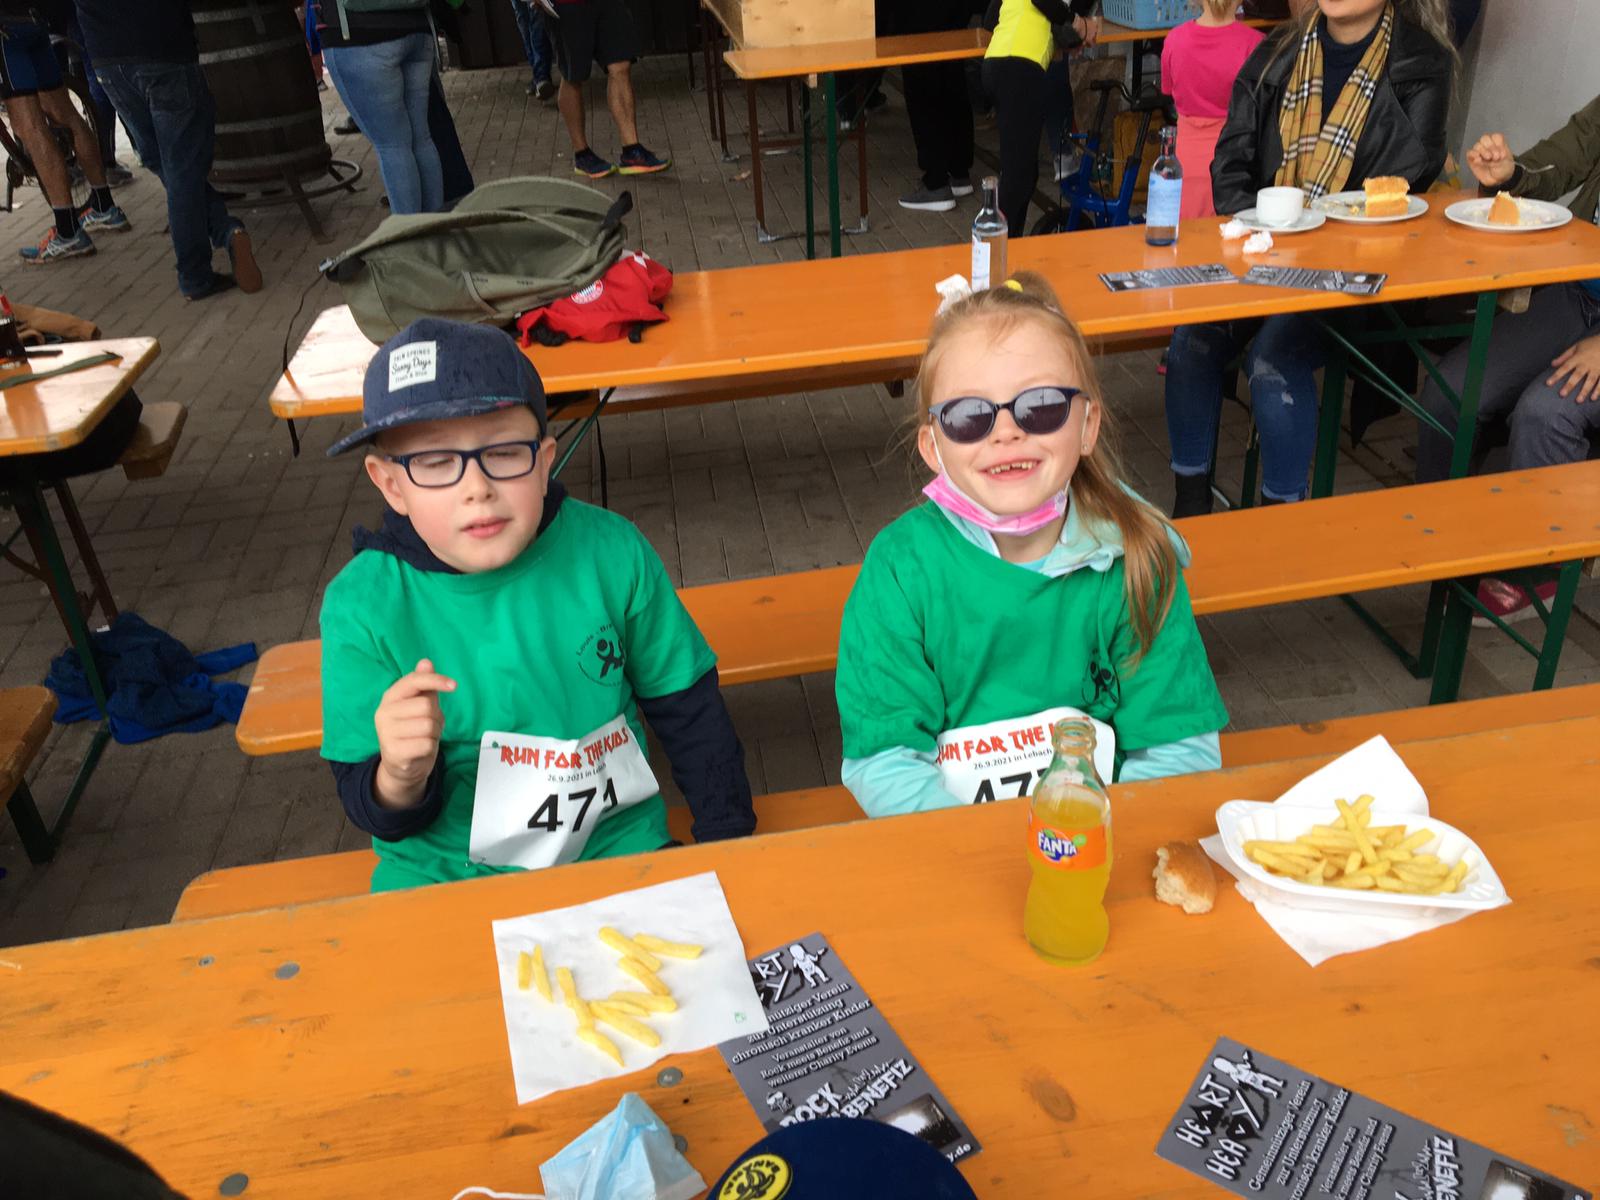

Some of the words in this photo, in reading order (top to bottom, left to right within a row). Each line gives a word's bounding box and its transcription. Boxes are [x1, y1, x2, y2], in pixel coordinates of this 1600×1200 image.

[500, 744, 540, 768] RUN
[544, 749, 582, 769] FOR
[583, 744, 604, 767] THE
[602, 726, 629, 755] KIDS
[963, 735, 1008, 761] FOR
[1008, 727, 1045, 754] THE
[974, 757, 1012, 770] 26.9.2021
[1014, 753, 1022, 762] in
[1023, 748, 1053, 761] Lebach
[548, 773, 584, 782] 26.9.2021
[527, 778, 618, 832] 471
[1038, 831, 1078, 855] FANTA
[767, 998, 845, 1035] Unterstützung
[813, 982, 850, 1002] Verein
[732, 1038, 788, 1064] chronisch
[787, 1016, 834, 1041] kranker
[833, 999, 871, 1021] Kinder
[760, 1065, 786, 1080] Rock
[786, 1052, 815, 1070] meets
[815, 1037, 851, 1057] Benefiz
[852, 1026, 870, 1041] und
[771, 1033, 831, 1062] Veranstalter
[829, 1027, 847, 1039] von
[767, 1067, 809, 1088] weiterer
[809, 1050, 845, 1071] Charity
[845, 1036, 877, 1055] Events
[840, 1058, 914, 1118] BENEFIZ
[1249, 1111, 1296, 1190] Gemeinnütziger
[1287, 1080, 1311, 1112] Verein
[1281, 1098, 1325, 1167] Unterstützung
[1306, 1121, 1334, 1164] kranker
[1324, 1088, 1349, 1124] Kinder
[1277, 1166, 1291, 1185] zur
[1319, 1141, 1350, 1193] Veranstalter
[1344, 1126, 1357, 1143] von
[1340, 1166, 1358, 1198] meets
[1365, 1117, 1378, 1137] und
[1361, 1152, 1384, 1186] Charity
[1374, 1124, 1393, 1154] Events
[1433, 1135, 1461, 1200] ENEFIZ
